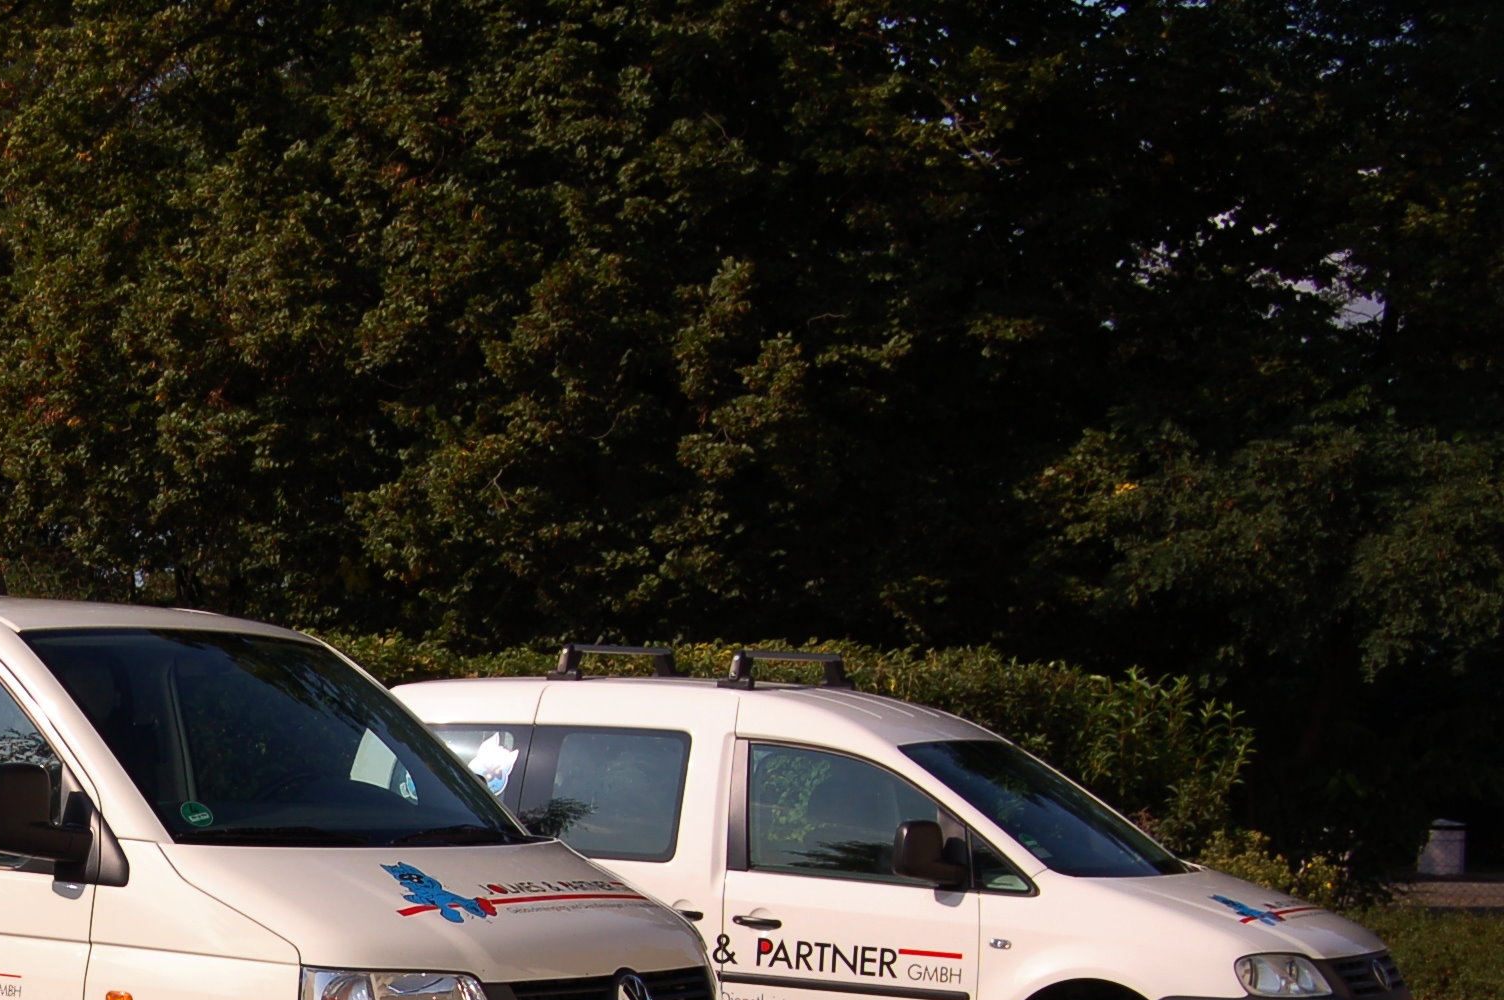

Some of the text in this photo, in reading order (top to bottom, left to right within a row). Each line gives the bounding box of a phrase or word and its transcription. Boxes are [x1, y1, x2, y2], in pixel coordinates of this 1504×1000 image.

[712, 933, 963, 985] & PARTNER GMBH
